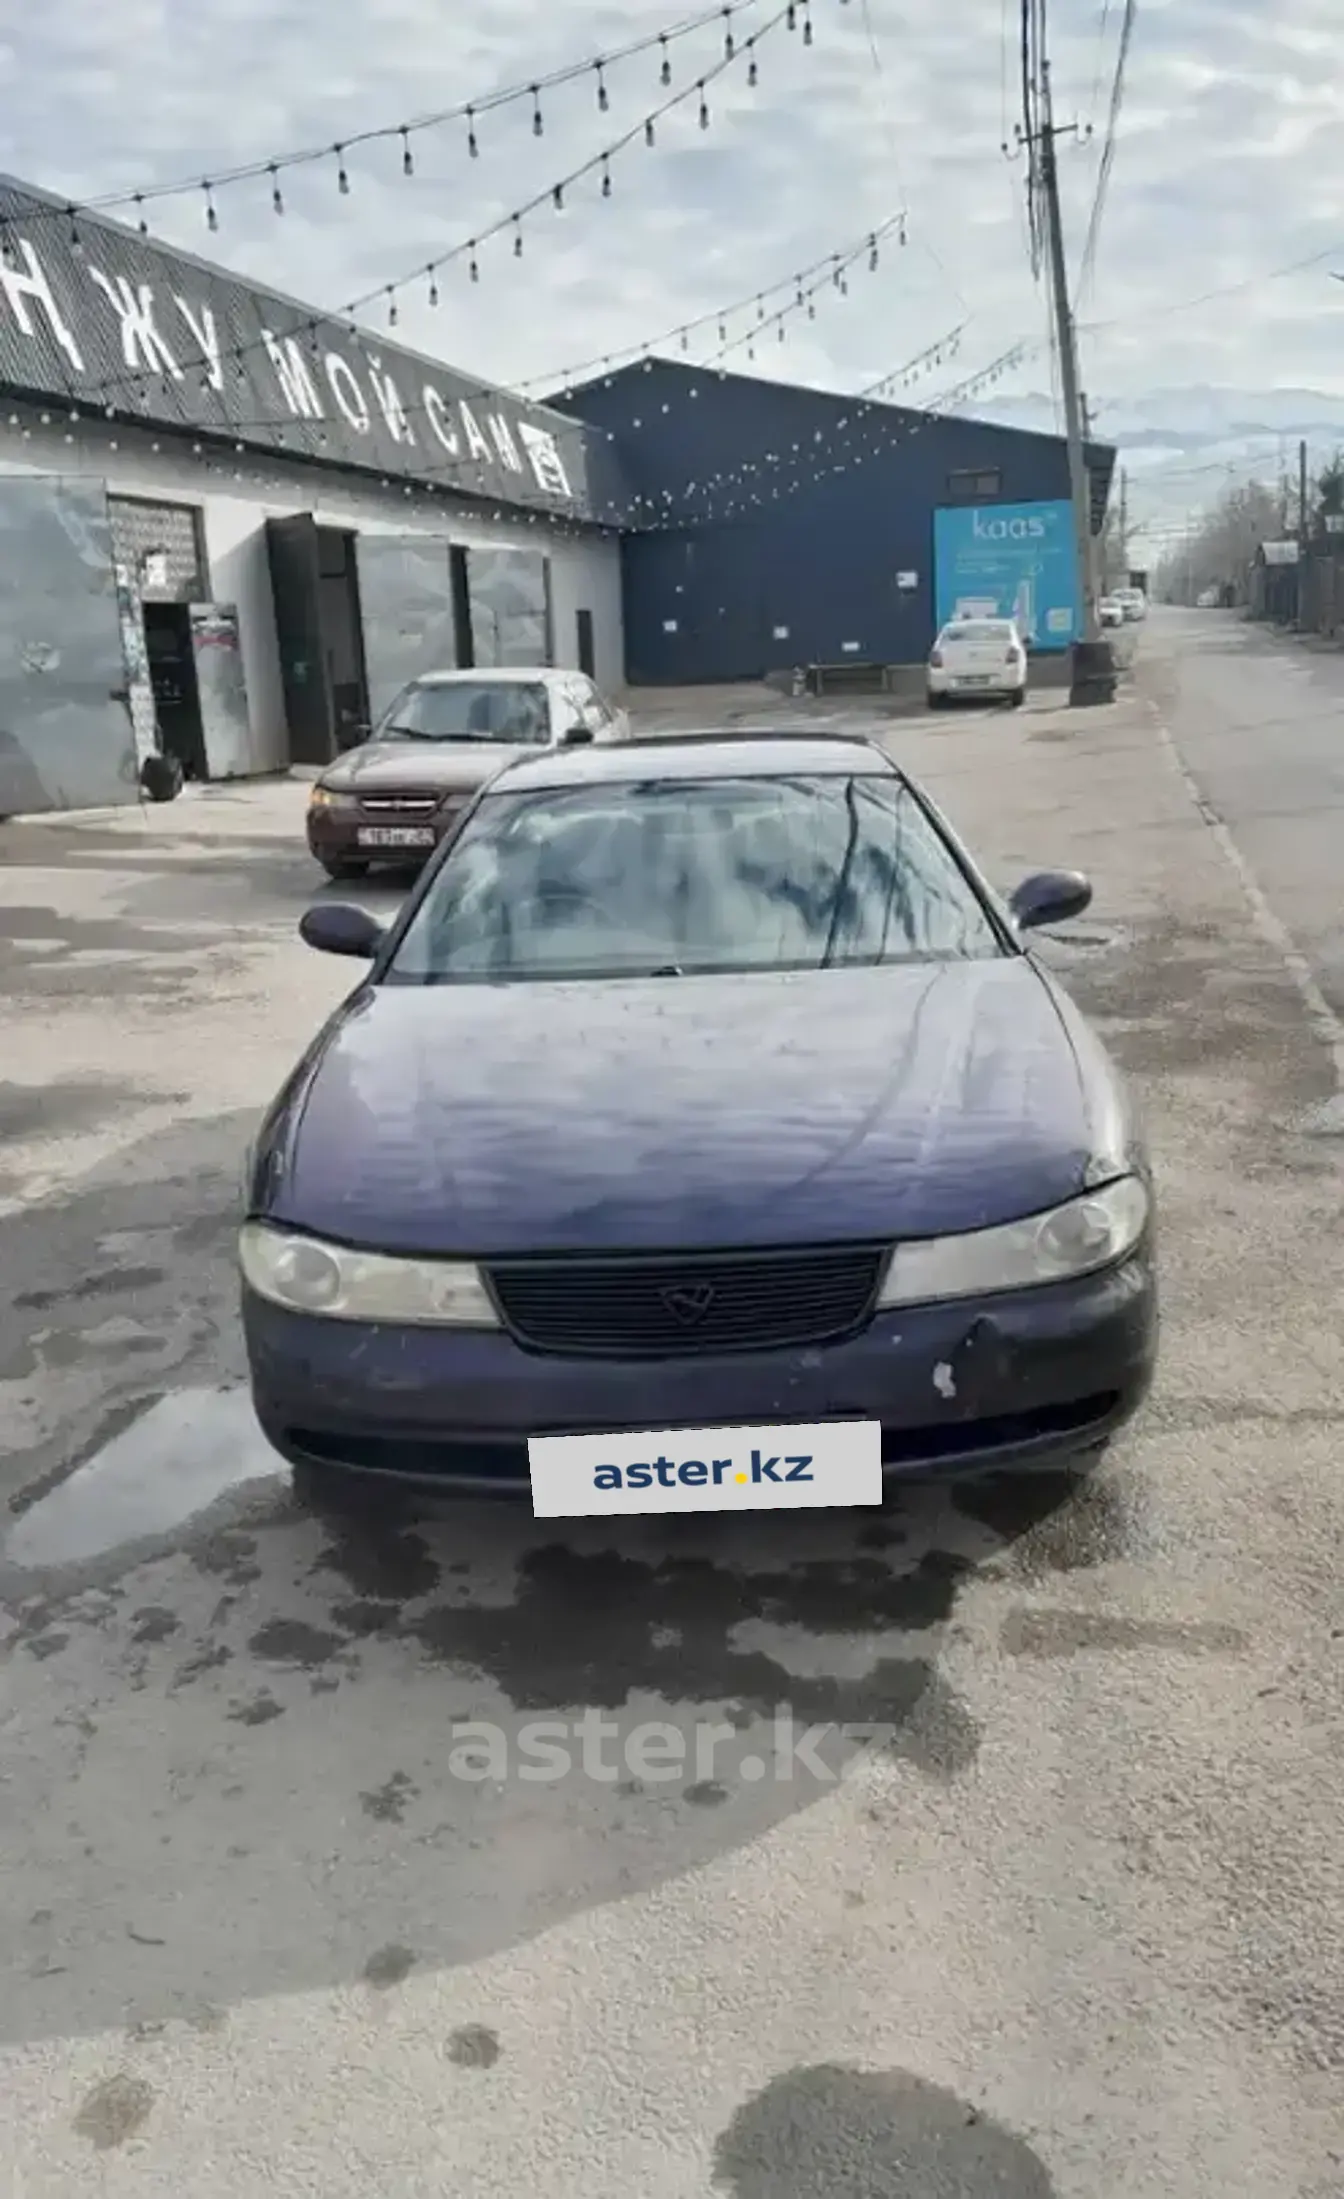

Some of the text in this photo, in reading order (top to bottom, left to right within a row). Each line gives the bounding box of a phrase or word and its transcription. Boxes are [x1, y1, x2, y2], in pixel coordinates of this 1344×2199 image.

[87, 265, 224, 390] ЖУ
[261, 329, 416, 446] МОЙ
[423, 385, 522, 473] САМ
